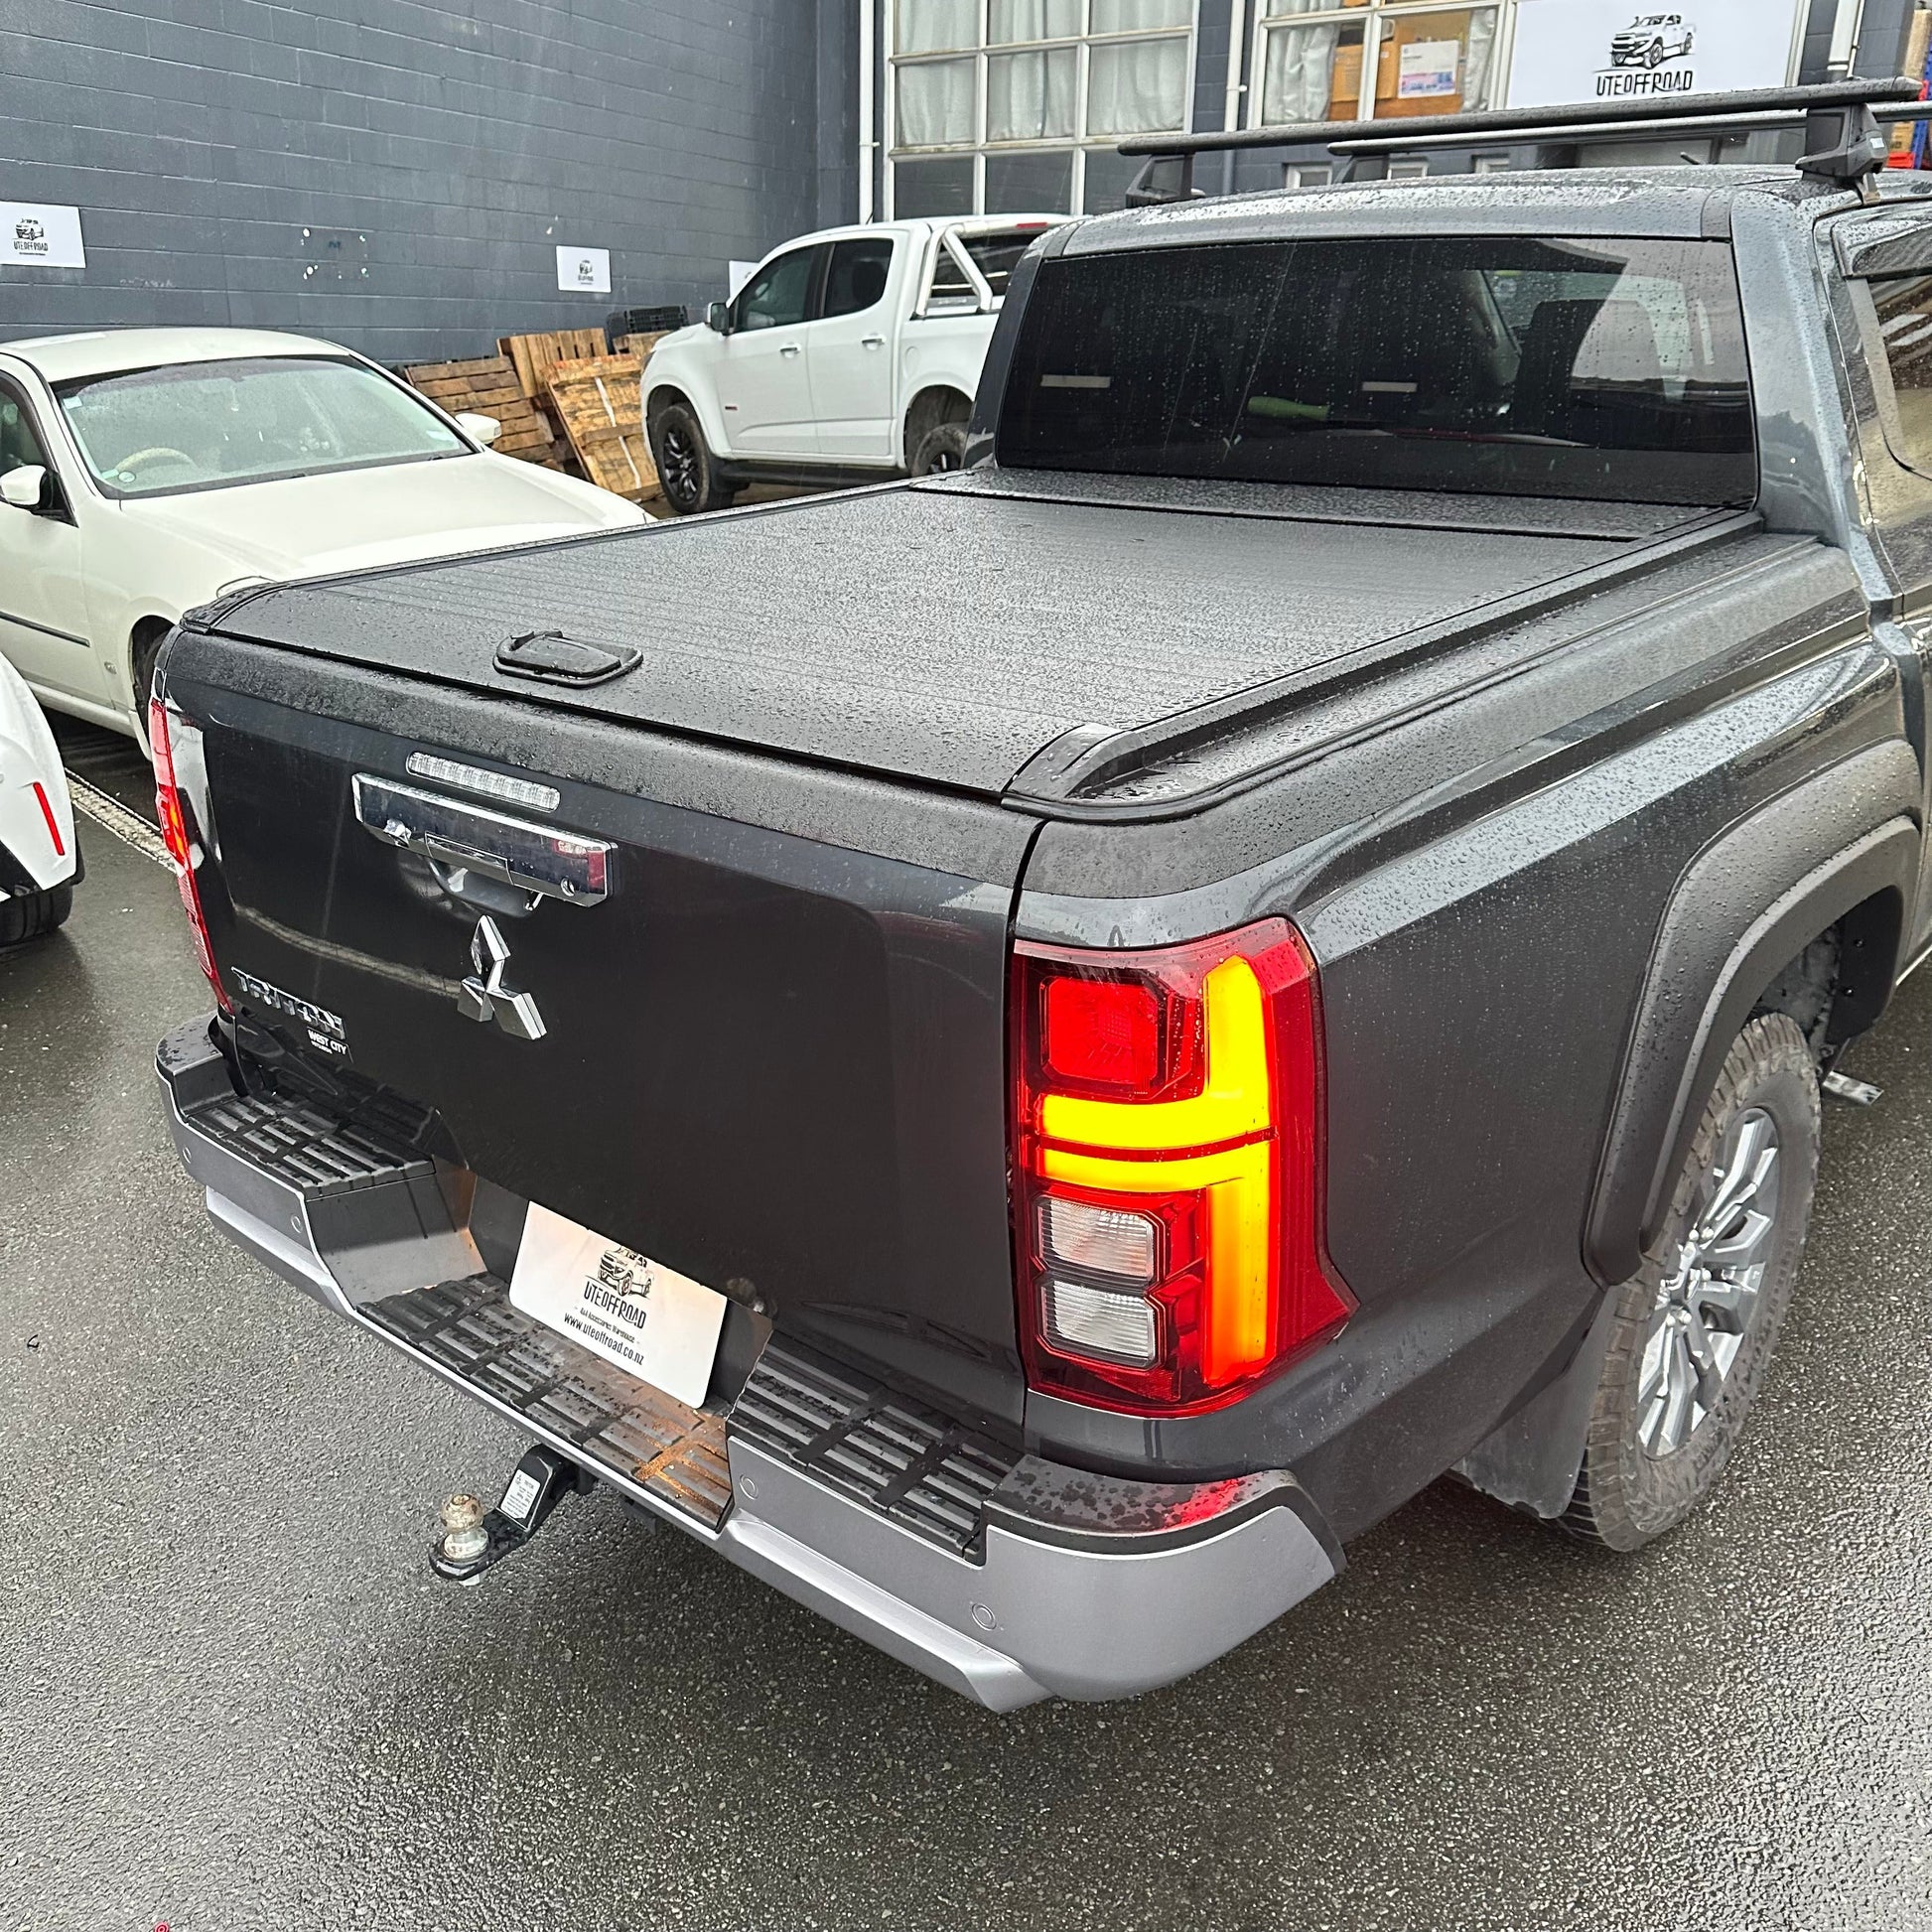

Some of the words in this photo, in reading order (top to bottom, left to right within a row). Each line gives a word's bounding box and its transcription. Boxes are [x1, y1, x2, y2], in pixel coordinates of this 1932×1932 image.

[1596, 70, 1693, 96] UTEOFFROAD
[230, 965, 345, 1040] TRITON
[308, 1030, 330, 1047] WEST
[330, 1041, 346, 1055] CITY
[584, 1281, 647, 1329] UTEOFFROAD
[564, 1311, 645, 1366] www.uteoffroad.co.nz
